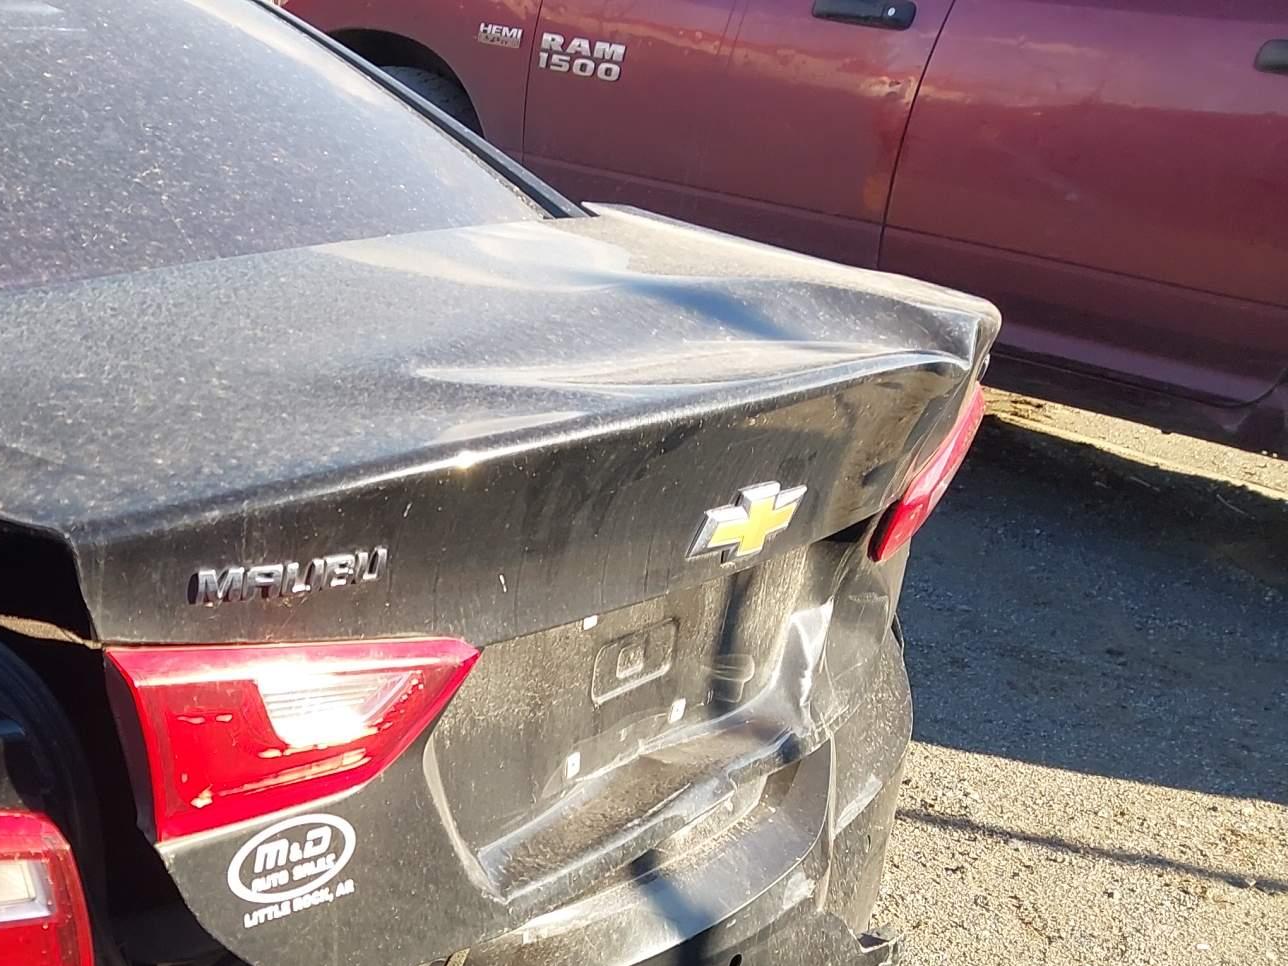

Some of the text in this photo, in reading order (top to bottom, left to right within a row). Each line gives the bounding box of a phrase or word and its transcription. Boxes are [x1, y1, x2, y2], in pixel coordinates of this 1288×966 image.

[480, 22, 523, 39] HEMI
[541, 32, 626, 62] RAM
[538, 51, 621, 82] 1500
[187, 546, 388, 604] MALIBU
[252, 853, 336, 893] AUTO SALES
[244, 900, 291, 928] LITTLE
